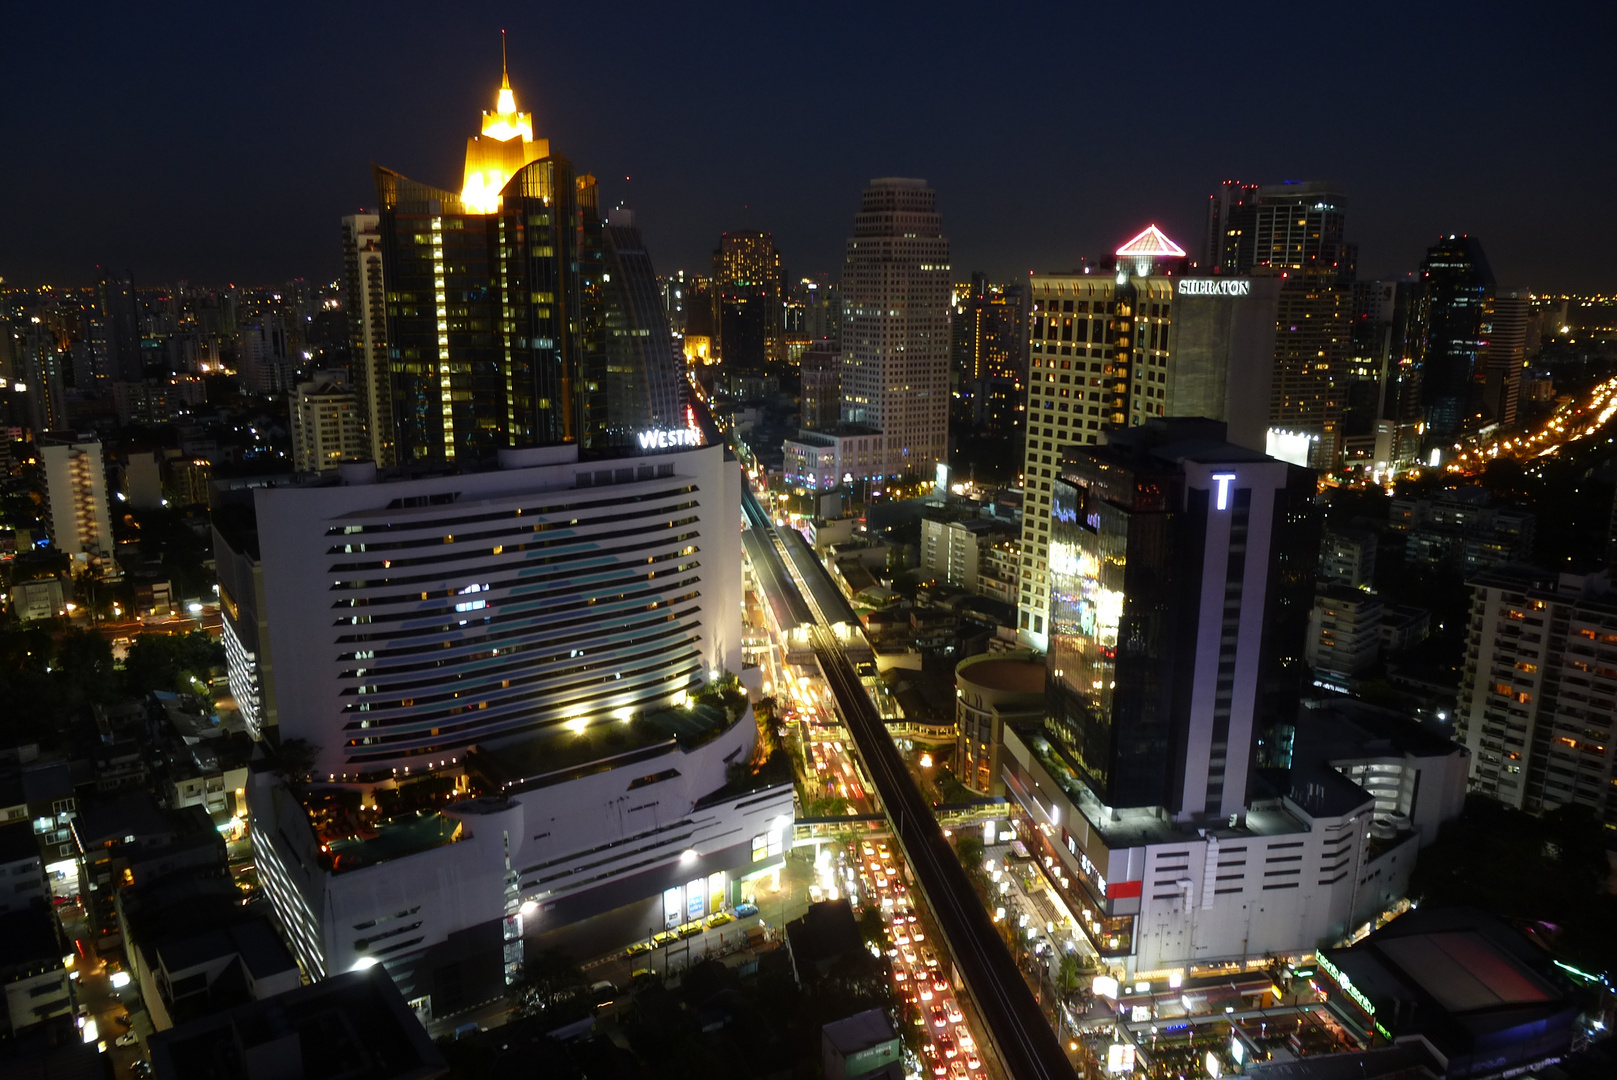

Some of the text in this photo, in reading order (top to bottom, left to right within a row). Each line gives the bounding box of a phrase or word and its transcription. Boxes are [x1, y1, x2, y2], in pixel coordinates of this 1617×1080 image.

[1179, 279, 1250, 296] SHERATON
[638, 429, 700, 449] WESTIN
[1212, 474, 1236, 510] T
